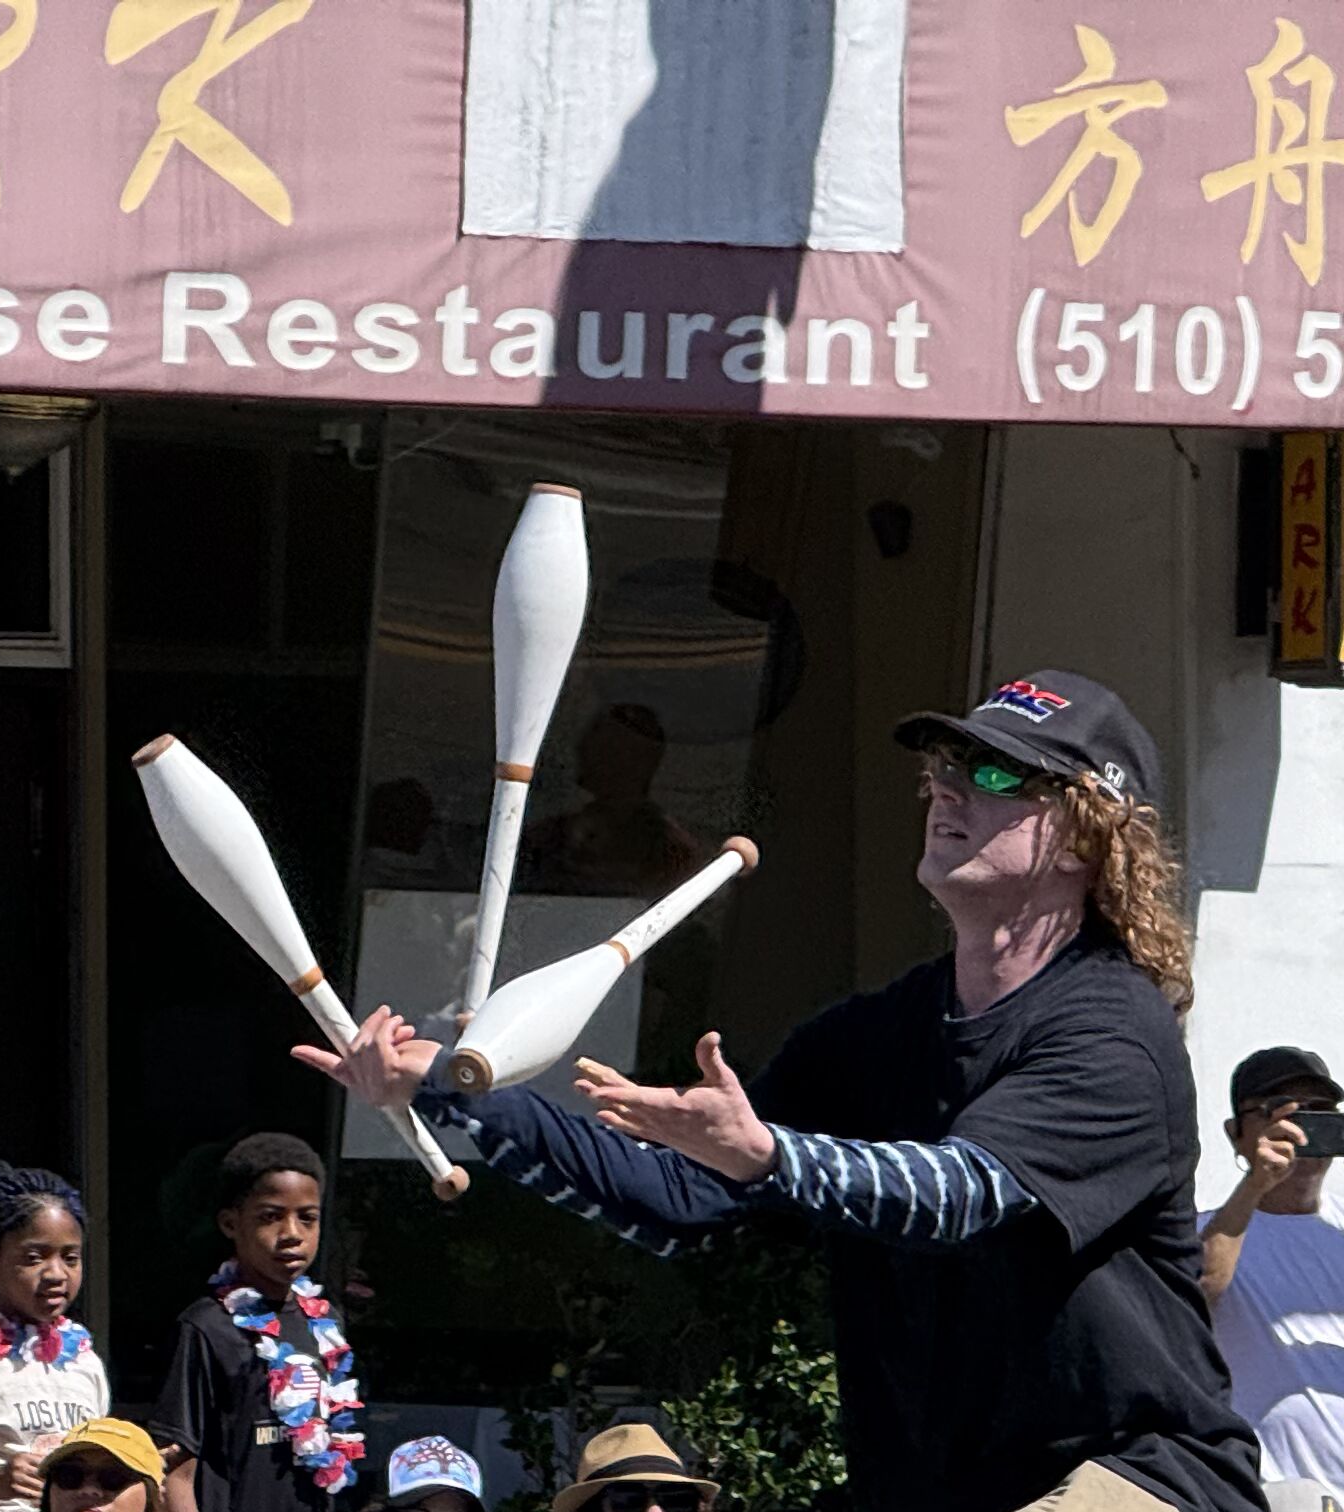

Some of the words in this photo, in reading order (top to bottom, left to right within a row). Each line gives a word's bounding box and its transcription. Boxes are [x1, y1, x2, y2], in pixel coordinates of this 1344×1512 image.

[160, 271, 931, 390] Restaurant
[1015, 287, 1262, 411] (510)
[1288, 457, 1321, 637] ARK
[13, 1399, 55, 1432] LOS
